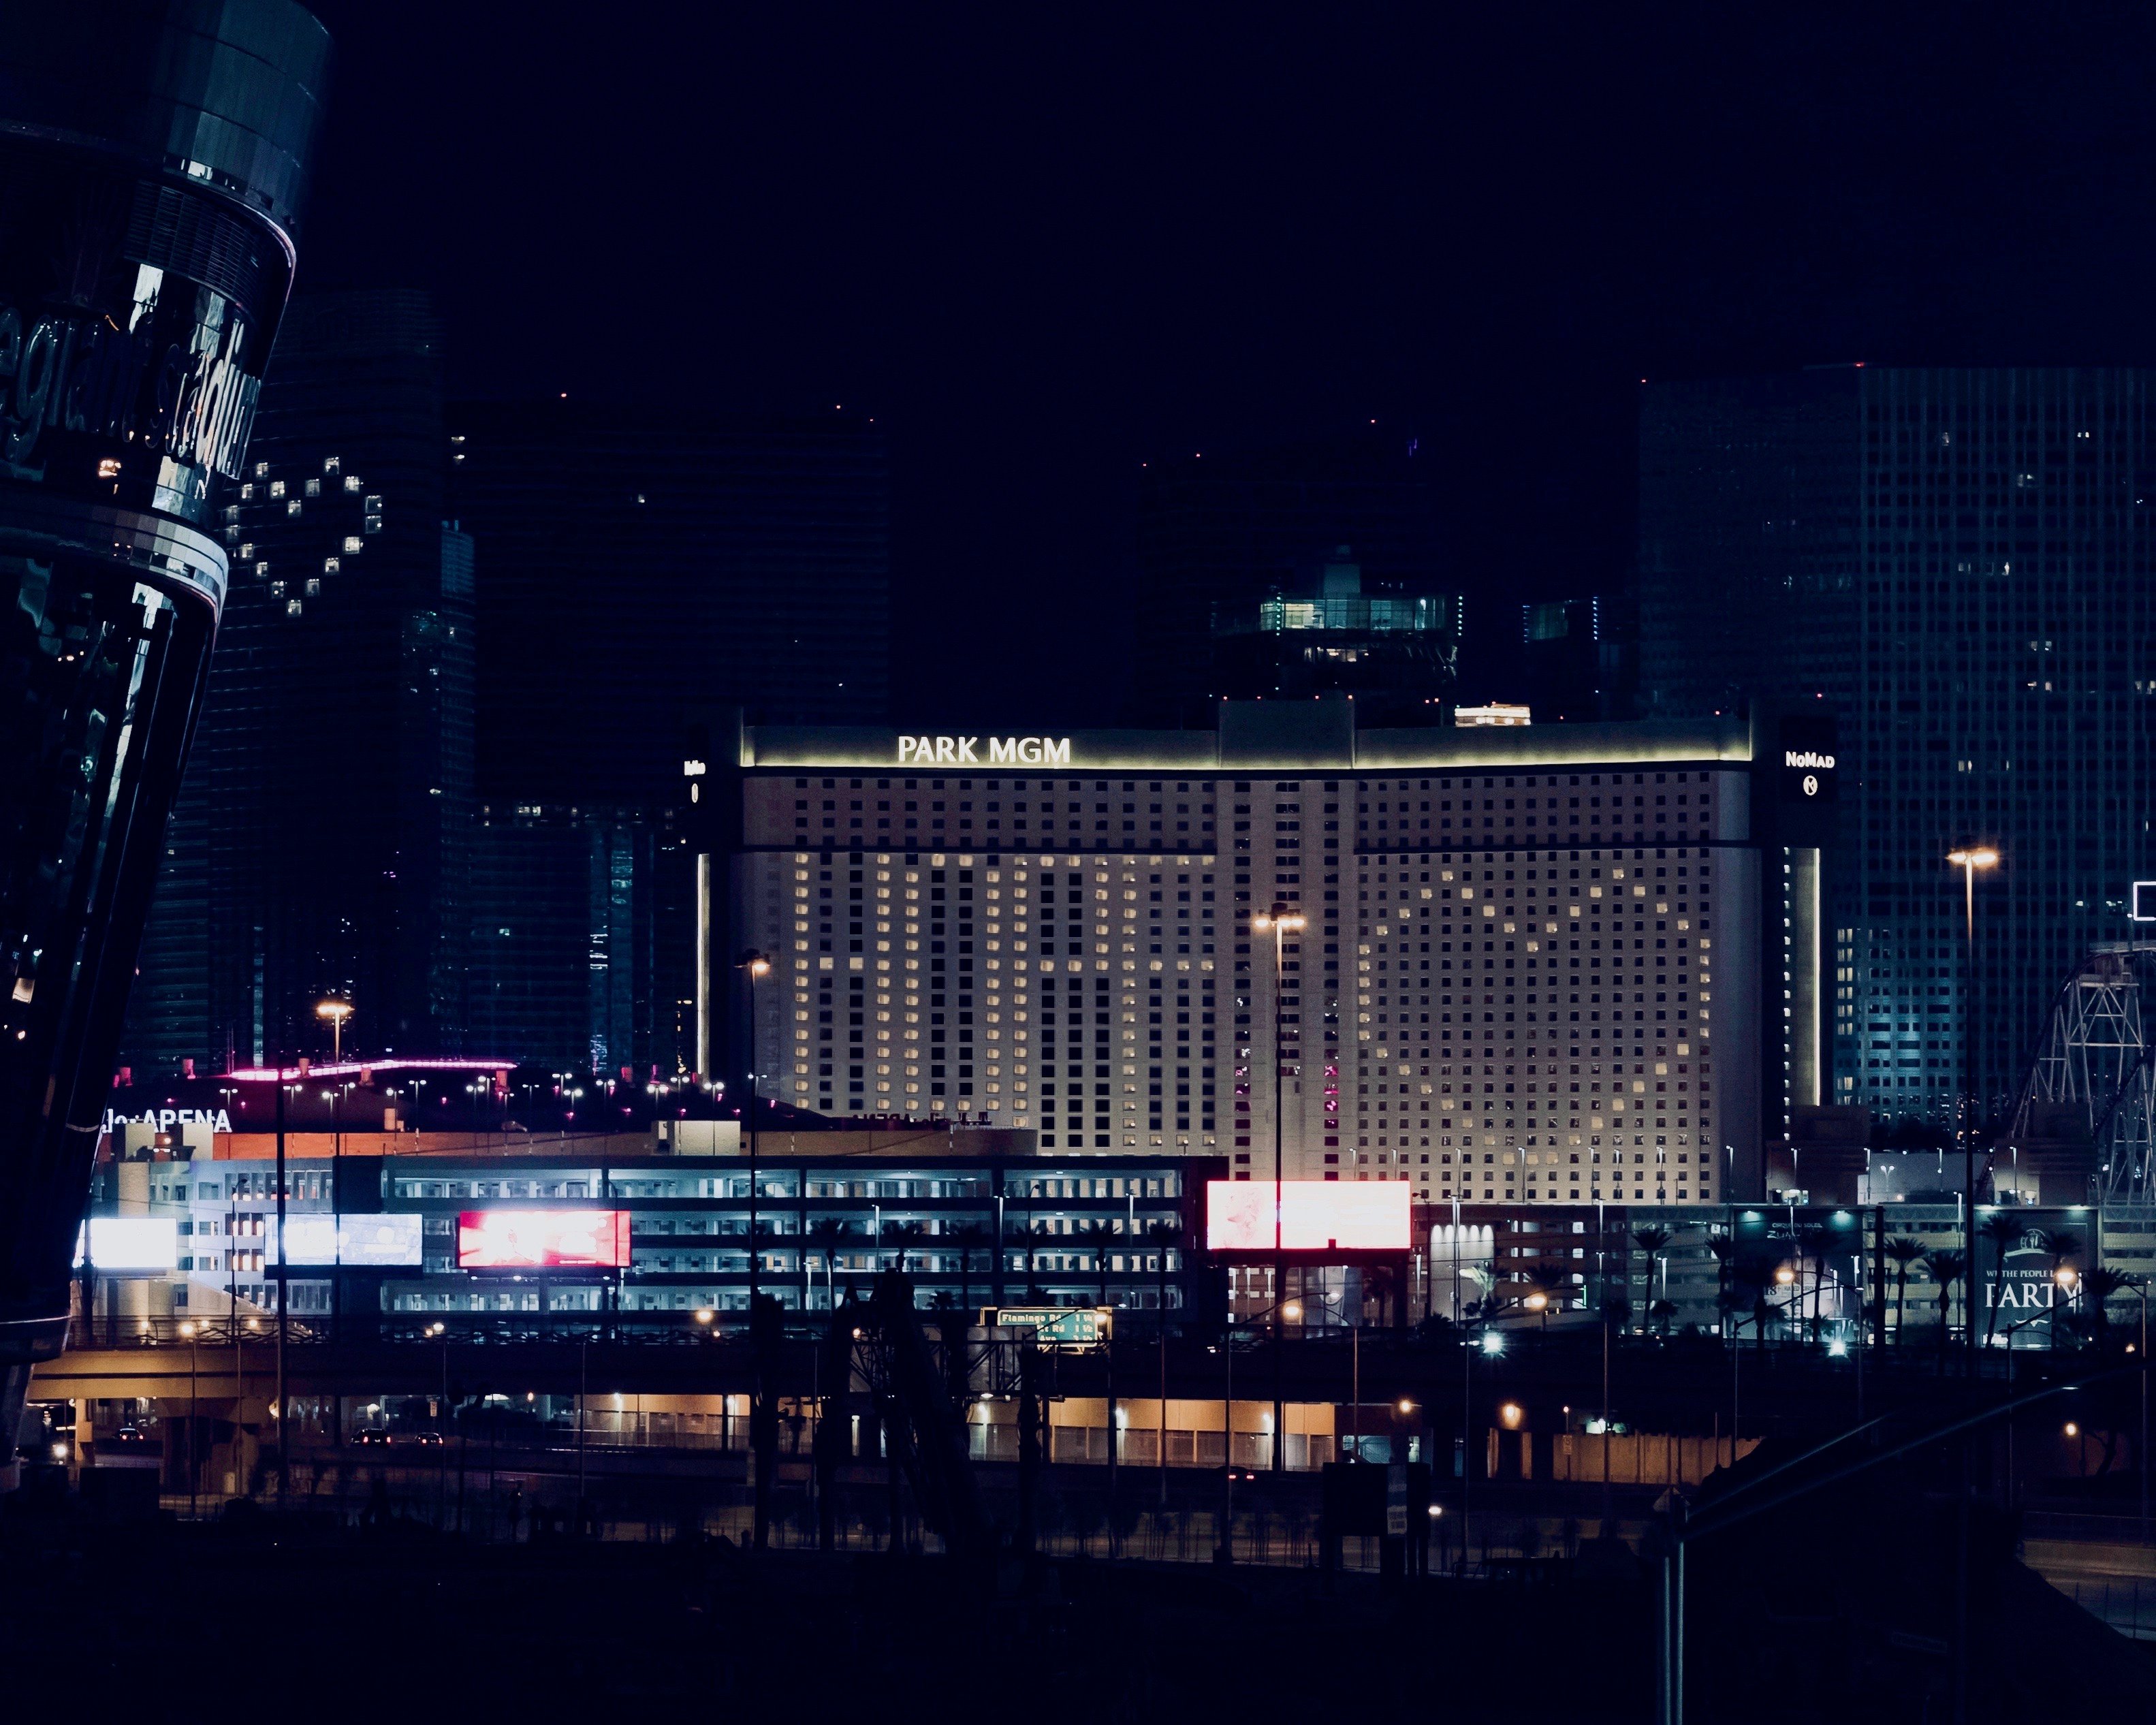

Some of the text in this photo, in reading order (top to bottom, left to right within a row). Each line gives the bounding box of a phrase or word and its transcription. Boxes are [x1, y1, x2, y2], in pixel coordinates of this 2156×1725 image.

[898, 735, 1071, 763] PARK MGM
[1002, 1314, 1046, 1324] Flamingo
[1052, 1325, 1065, 1333] Rd
